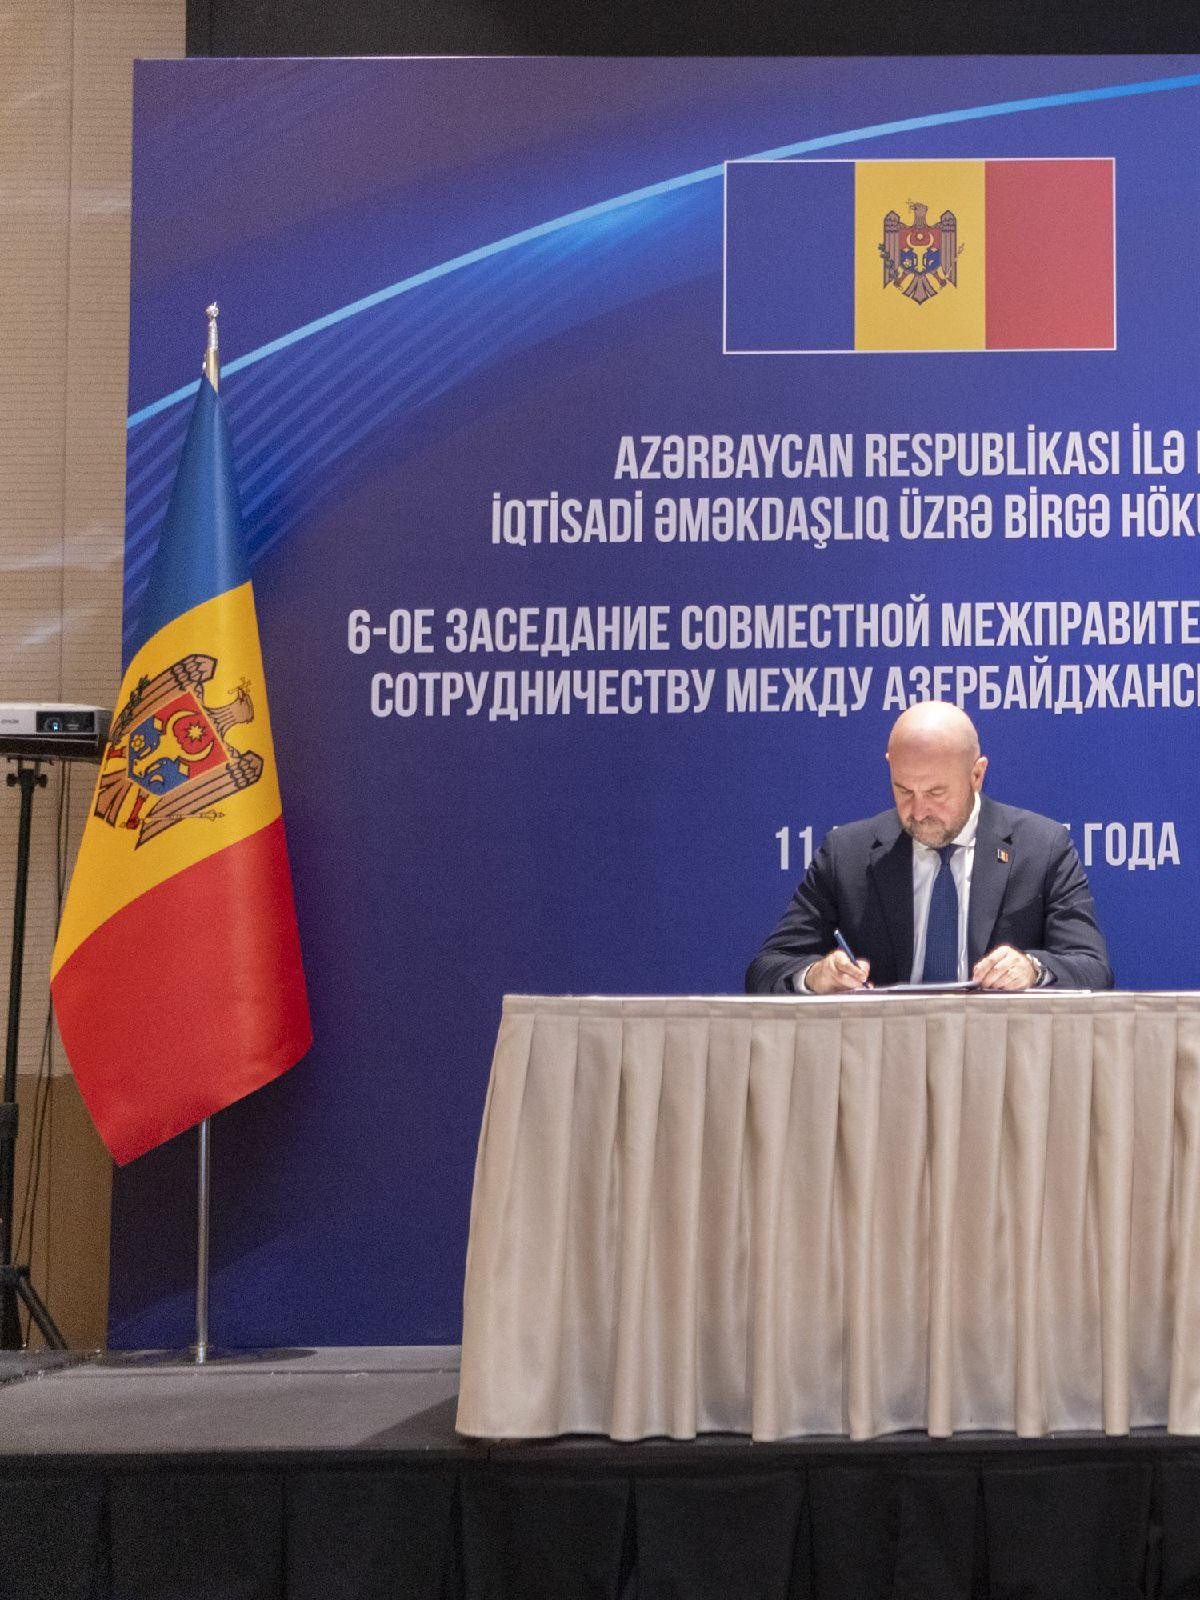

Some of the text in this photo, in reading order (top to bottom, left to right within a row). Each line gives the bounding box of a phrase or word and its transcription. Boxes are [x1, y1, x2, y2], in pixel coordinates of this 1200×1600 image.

[613, 433, 854, 480] AZƏRBAYCAN
[865, 423, 1120, 478] RESPUBLİKASI
[1132, 422, 1186, 475] İLƏ
[491, 489, 643, 547] İQTİSADİ
[654, 495, 890, 550] ƏMƏKDAŞLIQ
[899, 487, 993, 540] ÜZRƏ
[1004, 485, 1111, 539] BİRGƏ
[347, 608, 435, 655] 6-ОЕ
[445, 605, 671, 658] ЗАСЕДАНИЕ
[681, 593, 930, 651] СОВМЕСТНОЙ
[370, 668, 716, 722] СОТРУДНИЧЕСТВУ
[726, 666, 874, 718] МЕЖДУ
[775, 821, 1181, 871] 11 ГОДА
